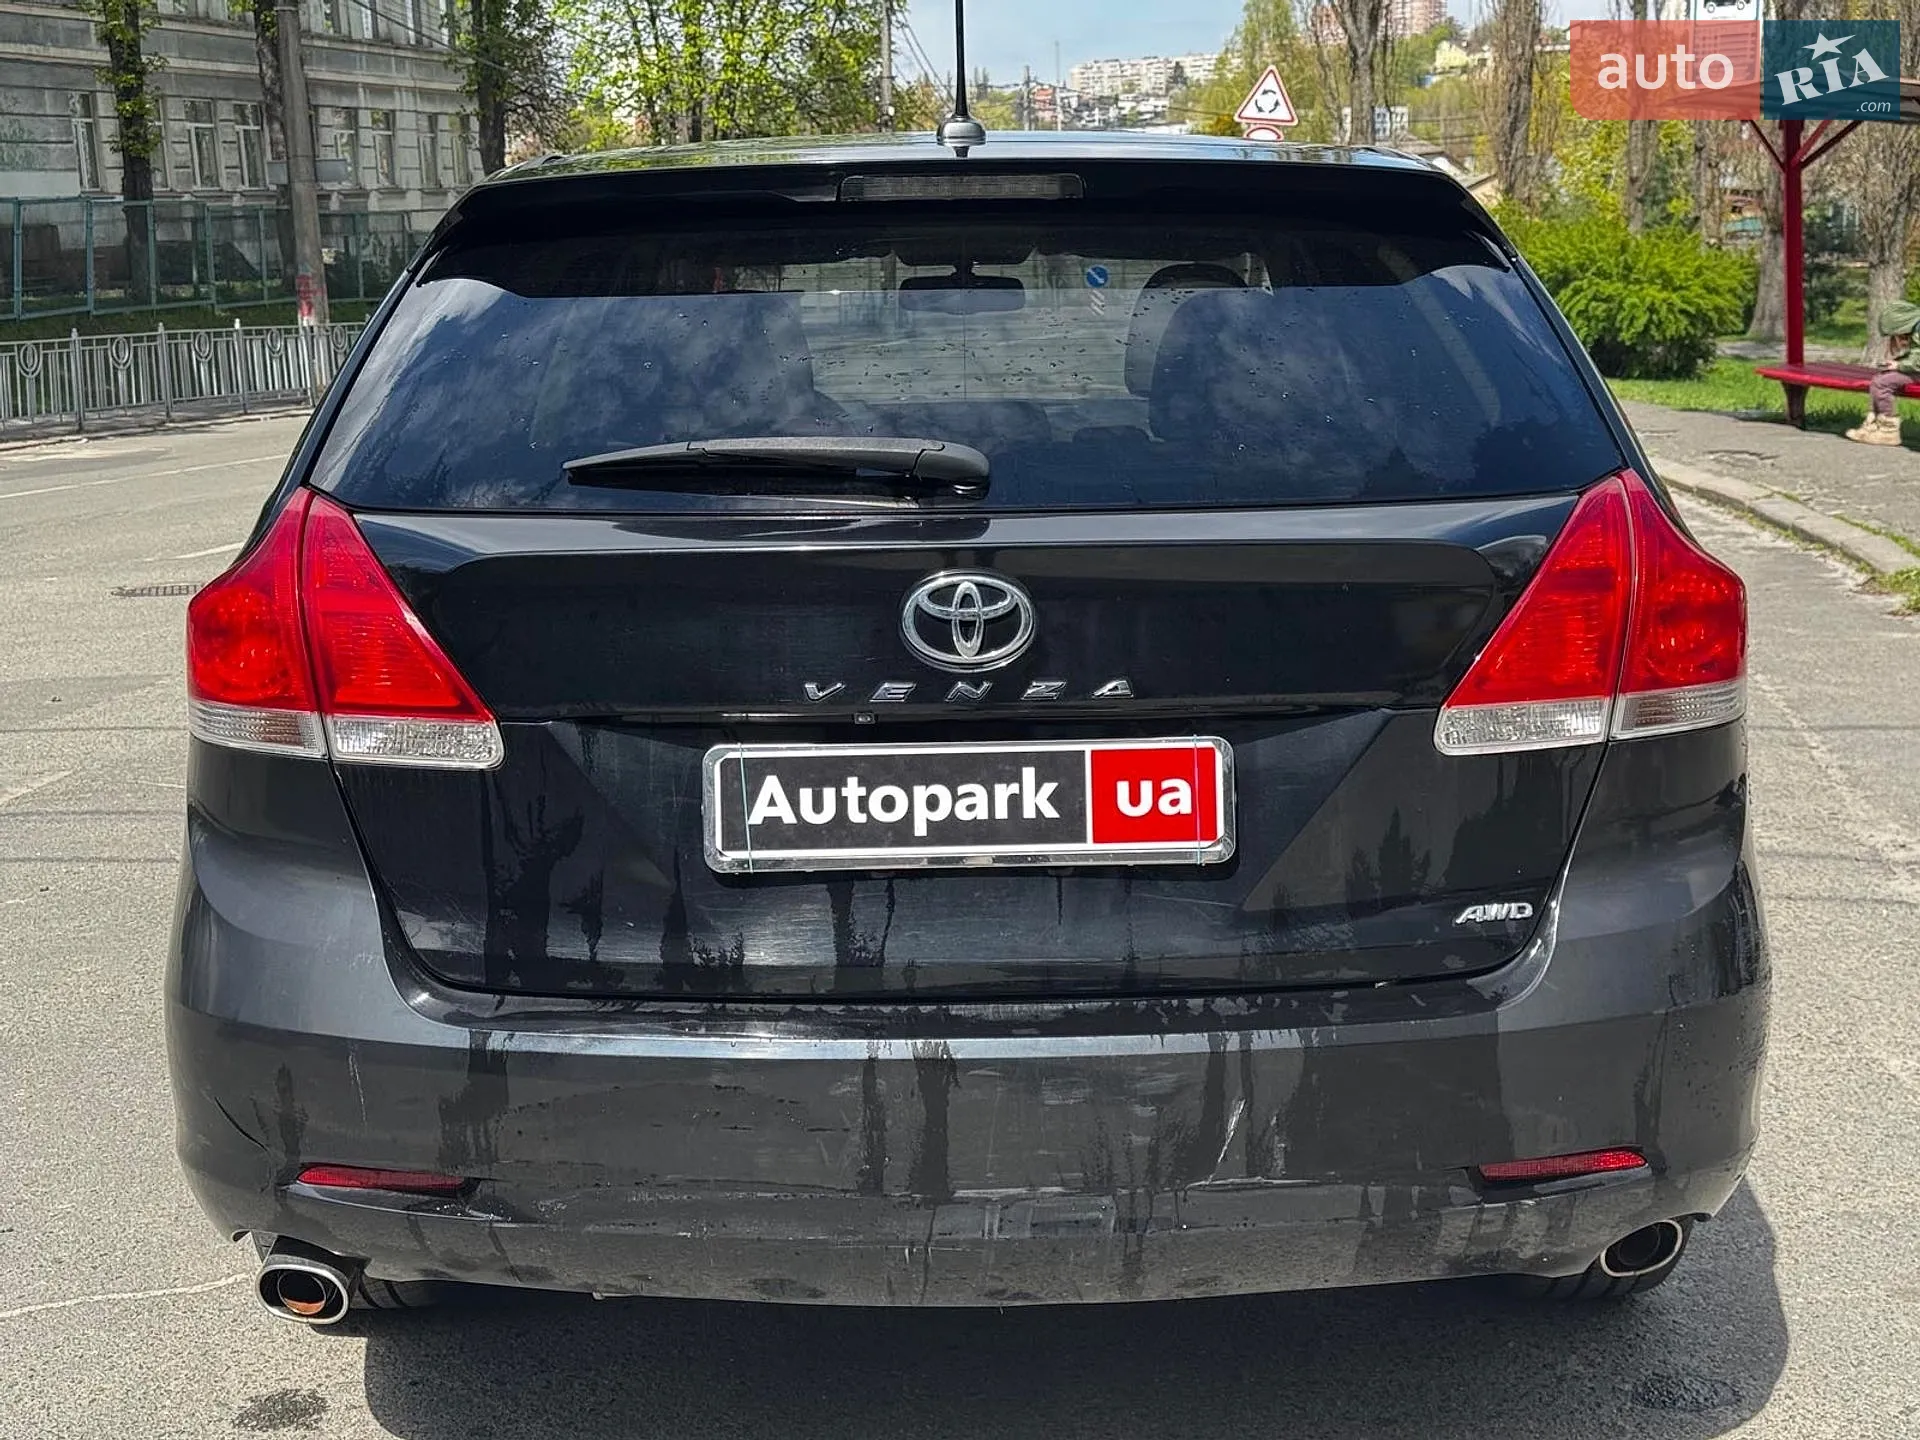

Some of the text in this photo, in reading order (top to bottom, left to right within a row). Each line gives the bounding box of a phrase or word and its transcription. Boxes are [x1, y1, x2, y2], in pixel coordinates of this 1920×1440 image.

[803, 679, 1134, 702] VENZA
[747, 766, 1193, 837] Autopark ua
[1454, 902, 1533, 924] AWD
